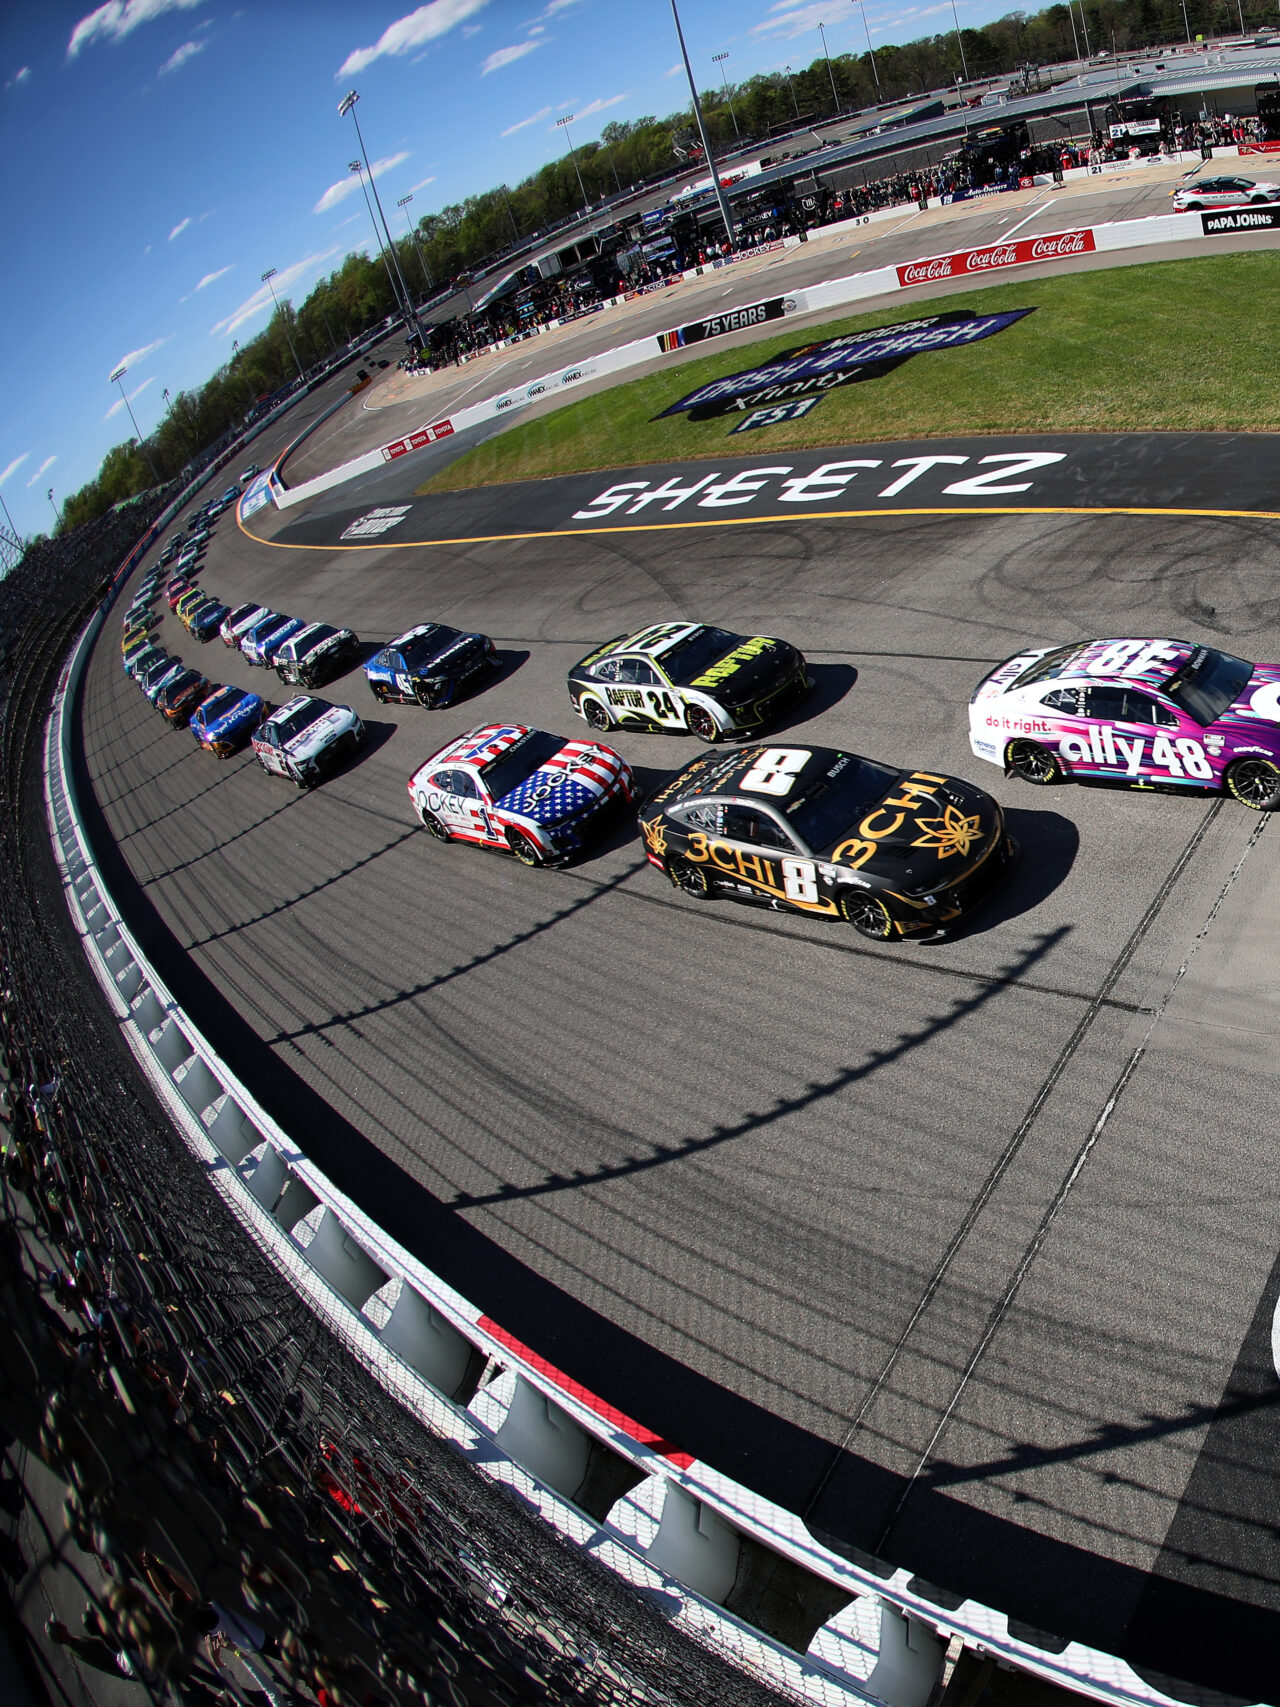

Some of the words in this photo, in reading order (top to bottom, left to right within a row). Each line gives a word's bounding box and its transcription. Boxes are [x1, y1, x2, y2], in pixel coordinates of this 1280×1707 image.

[1091, 166, 1102, 174] 21
[744, 210, 773, 226] JOCKEY
[1208, 215, 1235, 230] PAPA
[1235, 214, 1272, 228] JOHNS
[737, 244, 771, 261] JOCKEY
[966, 244, 1017, 270] Coca-Cola
[1031, 232, 1085, 258] Coca-Cola
[904, 257, 952, 284] Coca-Cola
[702, 319, 721, 339] 75
[722, 306, 767, 331] YEARS
[822, 317, 939, 352] NASCAR
[683, 356, 814, 406] DASH
[812, 349, 844, 370] 4
[846, 319, 997, 362] CASH
[737, 397, 817, 432] FS1
[412, 434, 427, 446] TOYOTA
[435, 424, 452, 436] TOYOTA
[571, 451, 1068, 520] SHEETZ
[689, 637, 777, 688] RAPTOR
[989, 663, 1023, 685] ally
[604, 686, 645, 708] RAPTOR
[647, 690, 680, 721] 24
[986, 715, 999, 728] do
[1002, 717, 1011, 730] it
[1014, 719, 1051, 734] right.
[1059, 724, 1147, 777] ally
[1153, 734, 1214, 780] 48
[522, 744, 602, 813] JOCKEY
[739, 749, 813, 797] 8
[827, 757, 851, 779] BUSCH
[415, 788, 466, 816] JOCKEY
[653, 773, 692, 803] 3CHI
[479, 804, 499, 841] 1
[831, 771, 949, 871] 3CHI
[685, 832, 777, 888] 3CHI
[781, 857, 819, 904] 8
